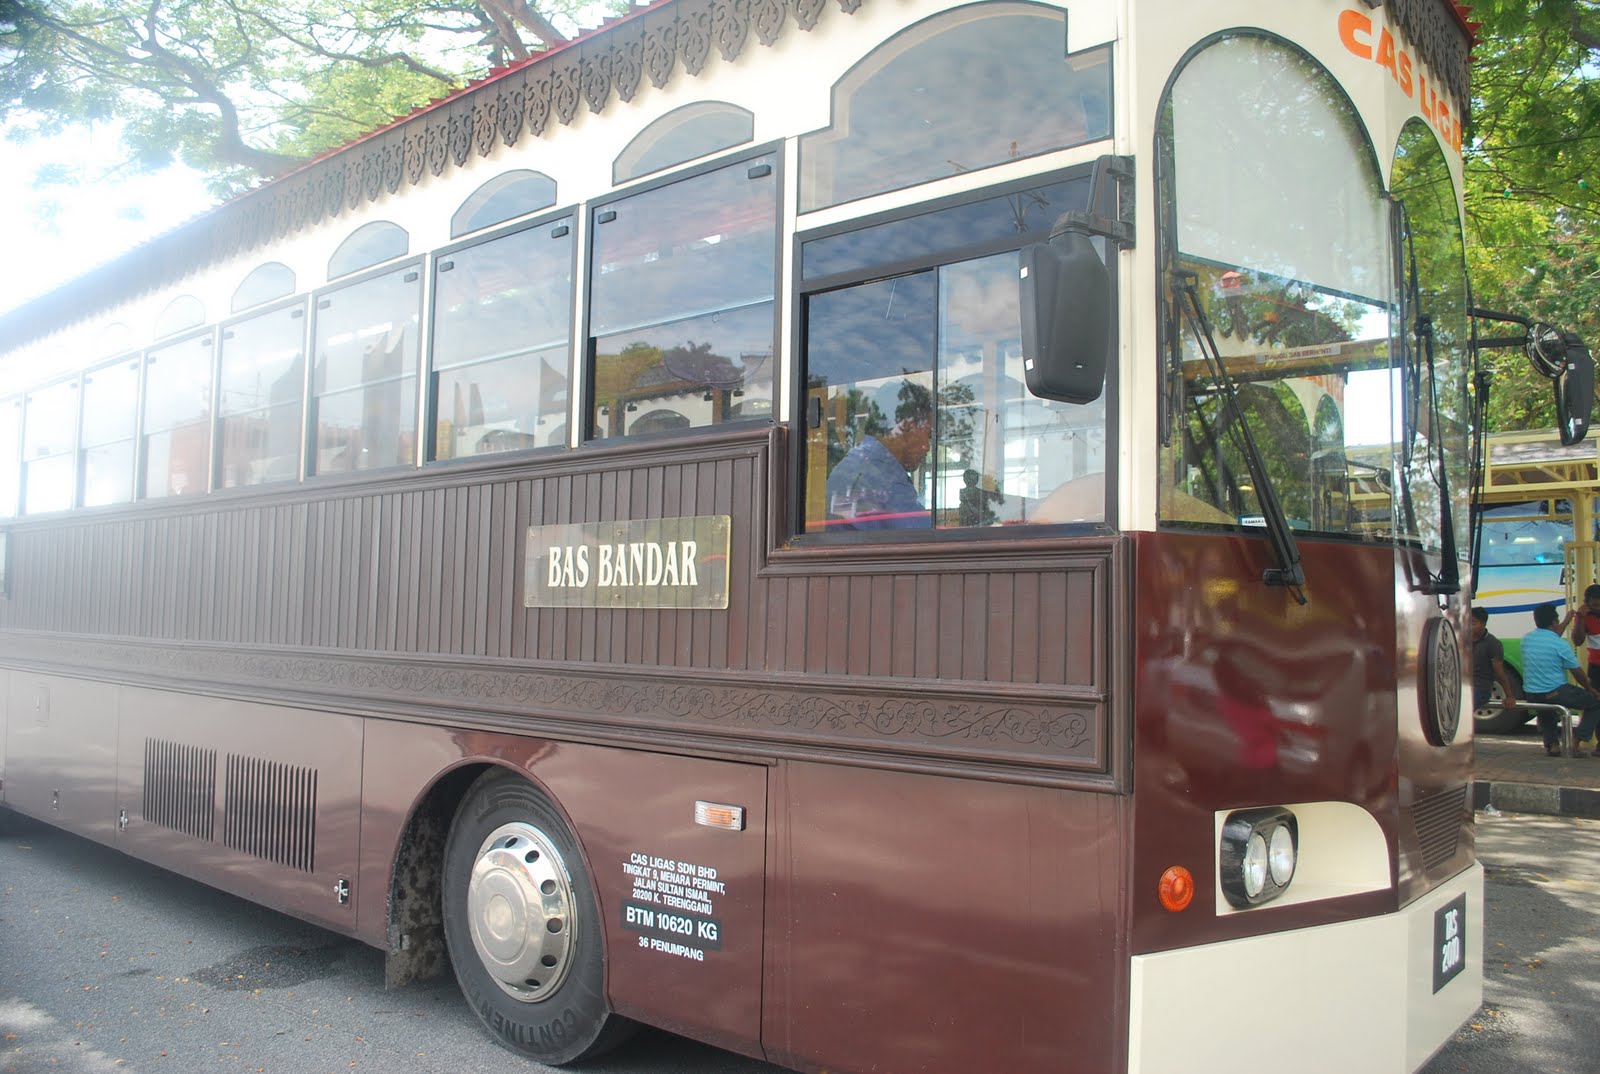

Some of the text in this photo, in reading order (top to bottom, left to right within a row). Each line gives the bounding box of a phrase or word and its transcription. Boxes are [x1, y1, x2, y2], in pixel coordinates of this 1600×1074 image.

[1338, 9, 1413, 99] CAS
[547, 541, 698, 588] BAS BANDAR
[622, 862, 726, 896] TINGKAT 9, MENARA PERMINT,
[630, 852, 717, 880] CAS LIGAS SDN BHD
[633, 877, 712, 905] JALAN SULTAN ISMAIL,
[653, 892, 662, 904] K.
[662, 894, 713, 915] TERENGGANU
[626, 906, 718, 941] BTM 10620 KG
[638, 935, 704, 962] 36 PENUMPANG
